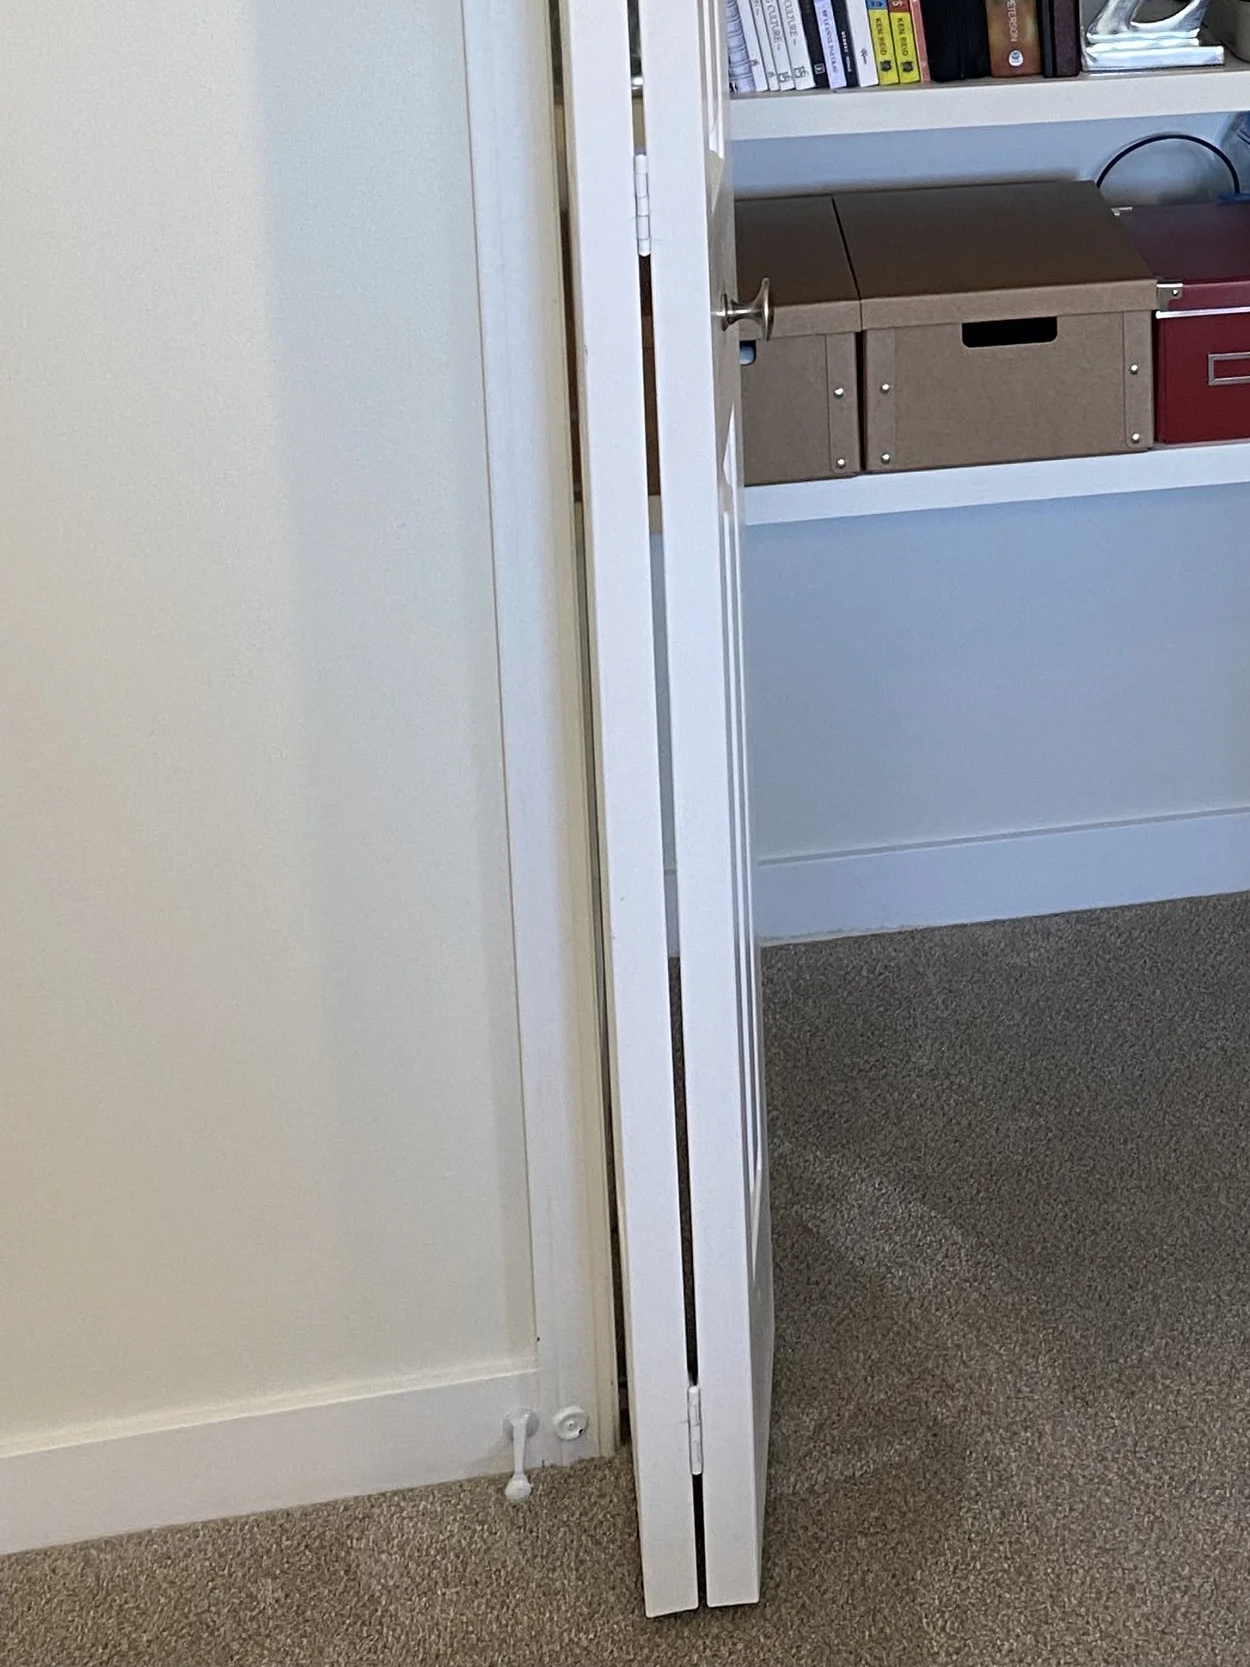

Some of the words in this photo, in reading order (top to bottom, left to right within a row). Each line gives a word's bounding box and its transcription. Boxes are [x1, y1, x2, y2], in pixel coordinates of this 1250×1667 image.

[765, 4, 782, 43] CULTURE
[783, 0, 797, 36] CULTURE
[875, 17, 884, 35] KEN
[897, 17, 905, 35] KEN
[900, 36, 909, 56] REID
